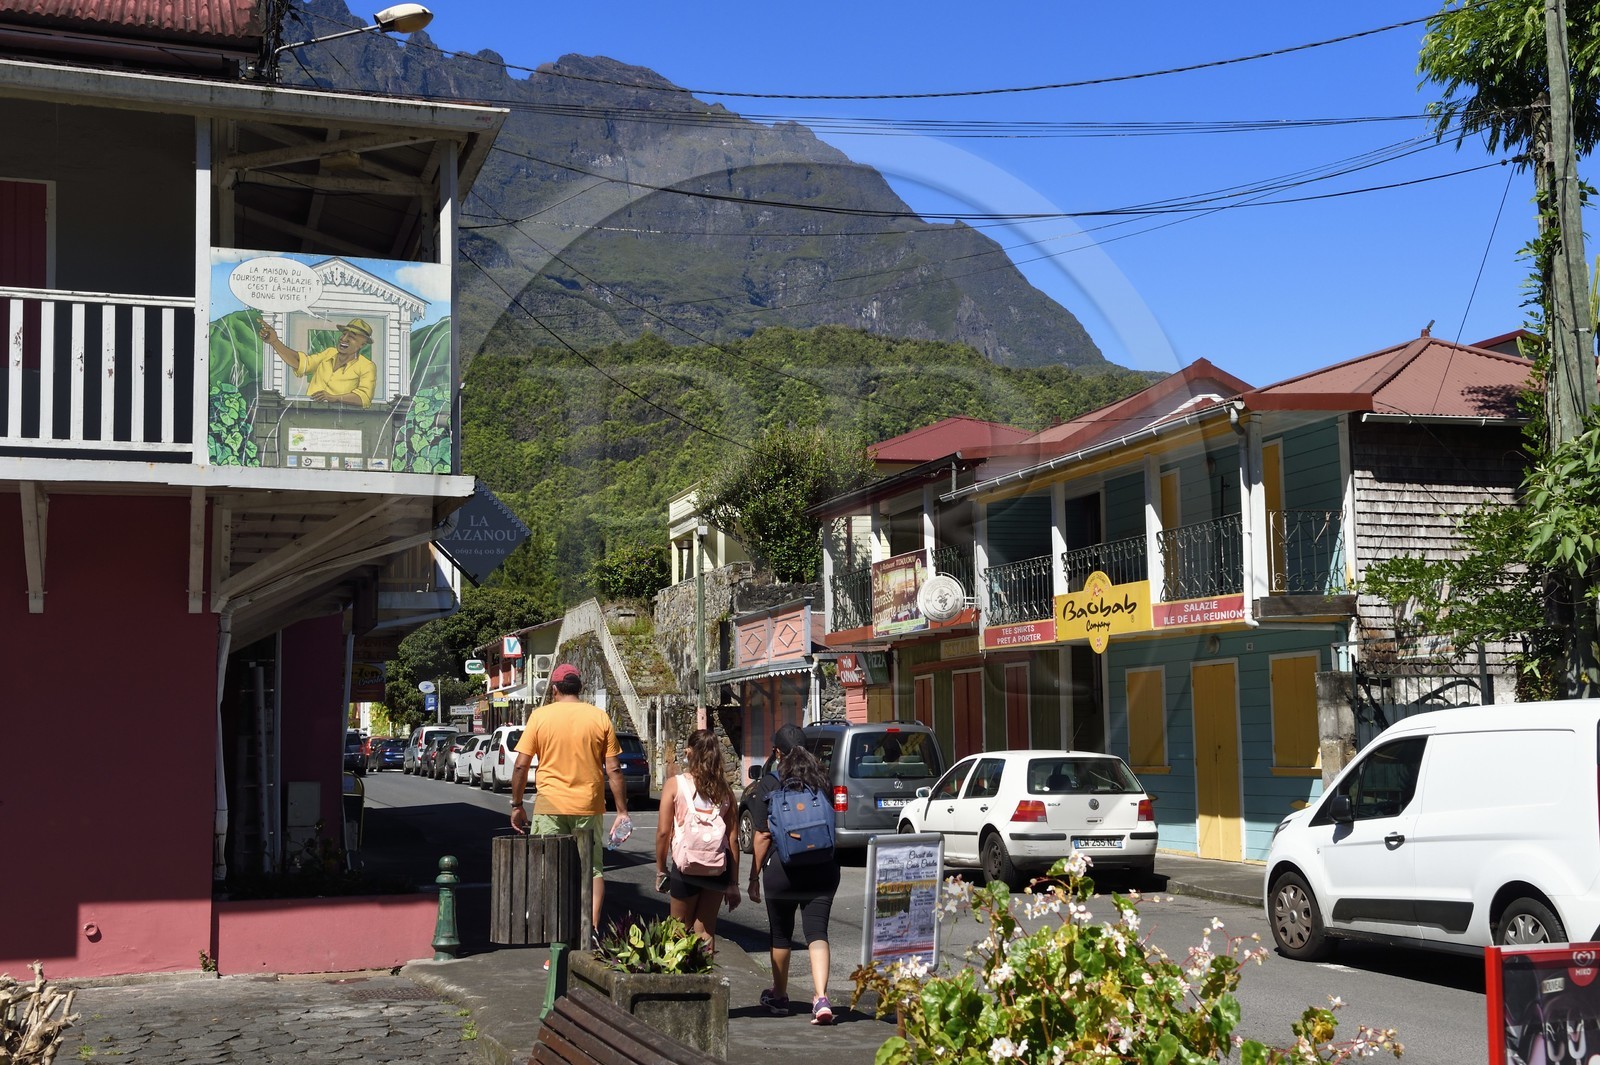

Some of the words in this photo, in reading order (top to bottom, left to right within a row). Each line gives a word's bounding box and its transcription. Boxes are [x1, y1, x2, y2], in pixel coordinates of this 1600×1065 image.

[233, 274, 264, 282] TOURISME
[470, 515, 489, 526] LA
[1063, 593, 1137, 621] Baobab
[1184, 601, 1218, 612] SALAZIE
[1164, 616, 1175, 625] ILE
[1178, 614, 1188, 623] DE
[1190, 613, 1200, 622] LA
[1204, 610, 1242, 621] REUNION
[1014, 625, 1034, 634] SHIRTS
[1086, 620, 1110, 632] Company
[1018, 633, 1041, 642] PORTER
[868, 653, 887, 669] PIZZA
